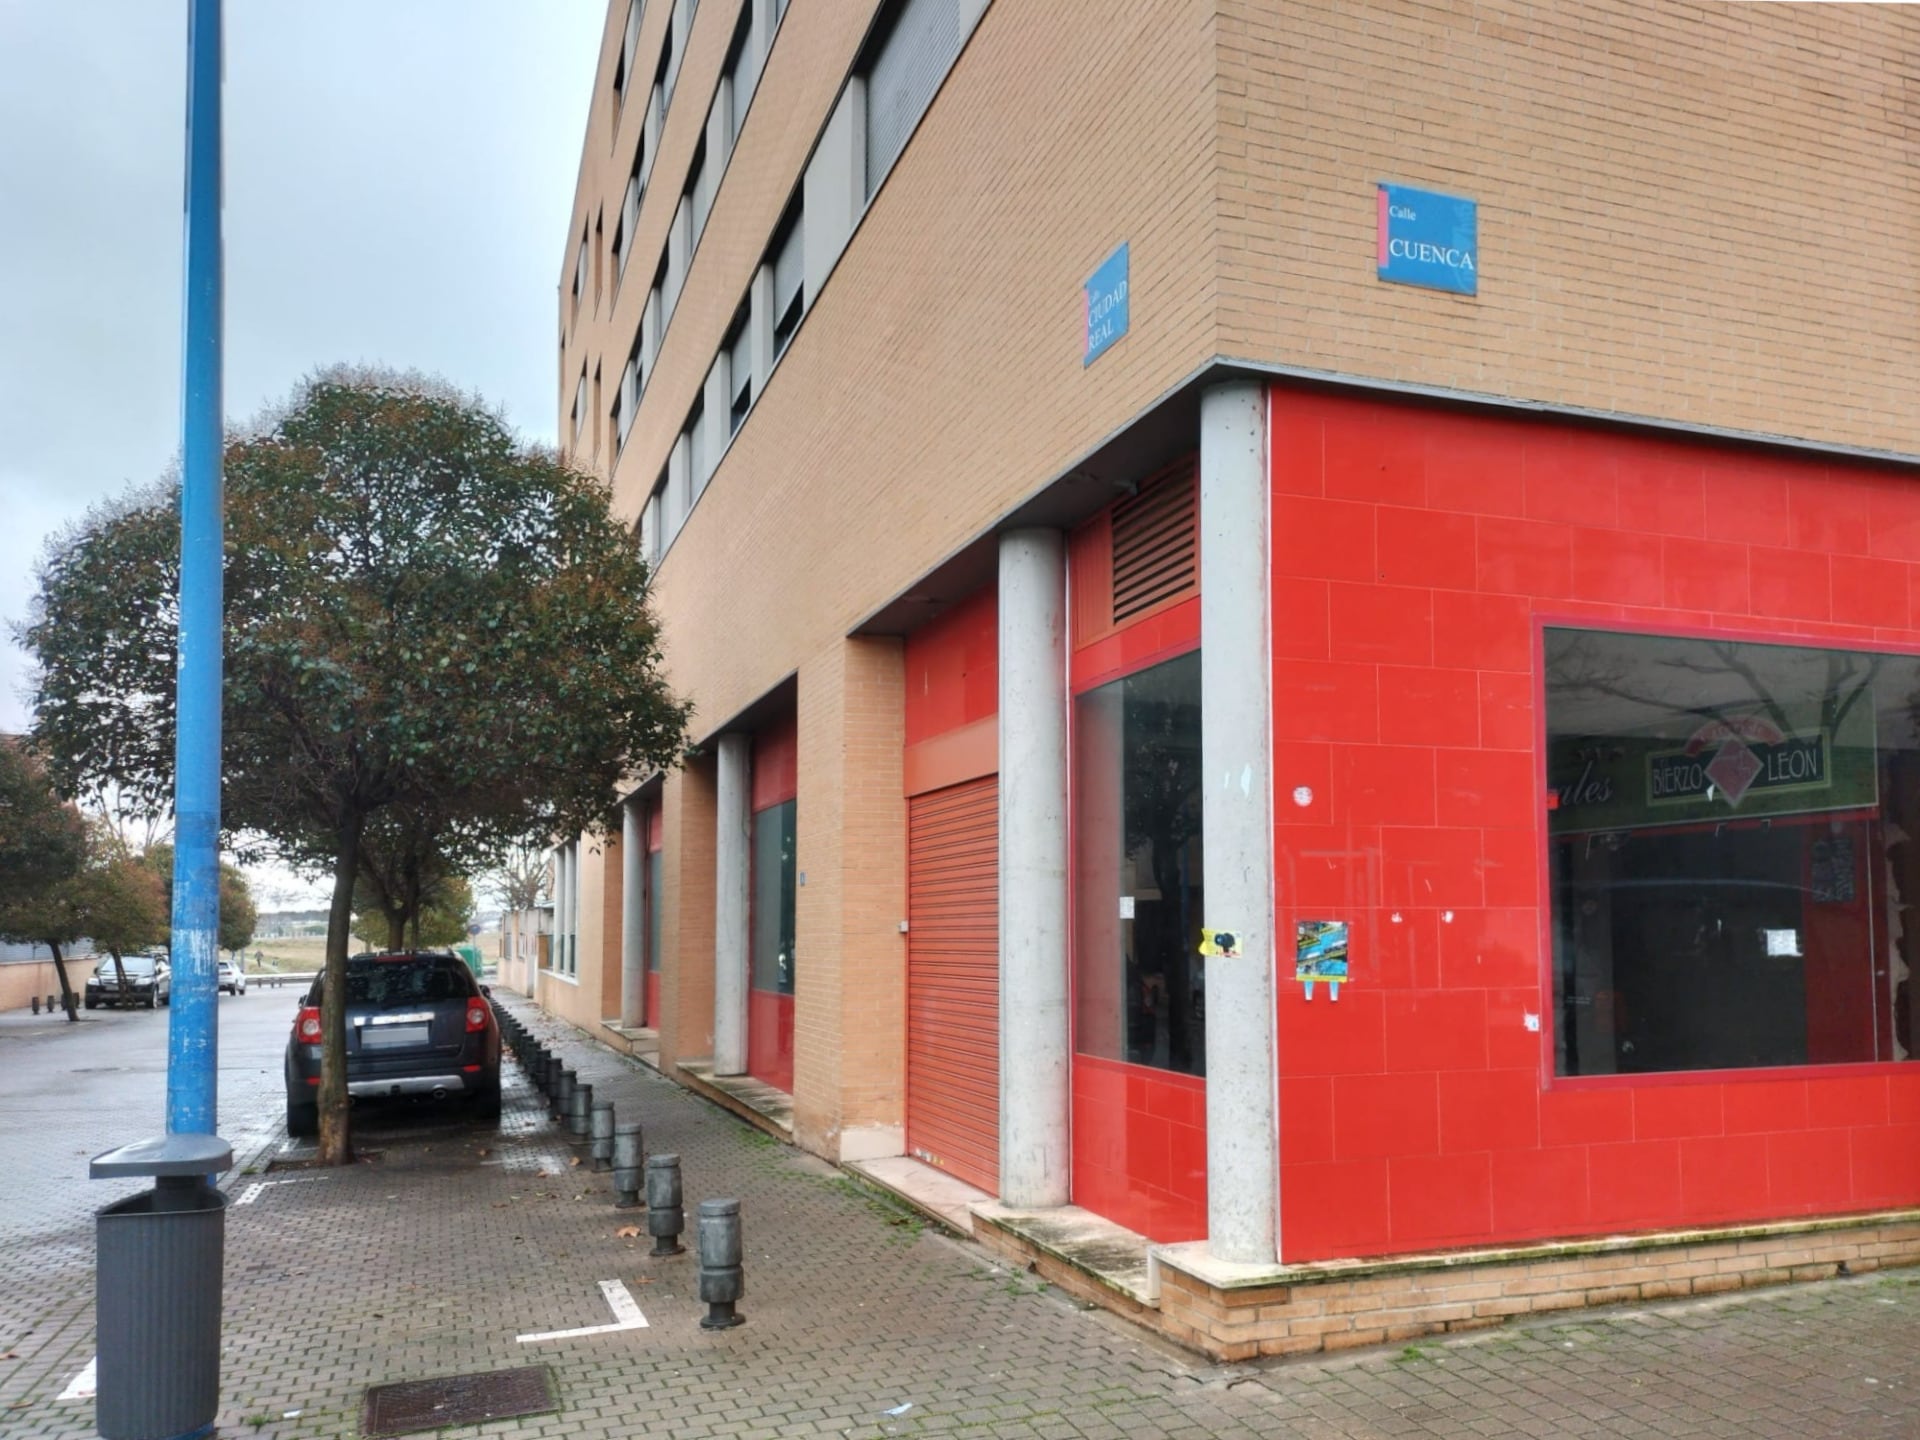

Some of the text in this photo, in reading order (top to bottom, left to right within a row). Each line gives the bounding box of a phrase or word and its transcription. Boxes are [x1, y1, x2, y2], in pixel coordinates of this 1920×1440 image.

[1389, 205, 1416, 221] Calle
[1390, 238, 1474, 270] CUENCA
[1088, 280, 1127, 328] CIUDAD
[1089, 319, 1114, 352] REAL
[1767, 748, 1817, 782] LEON
